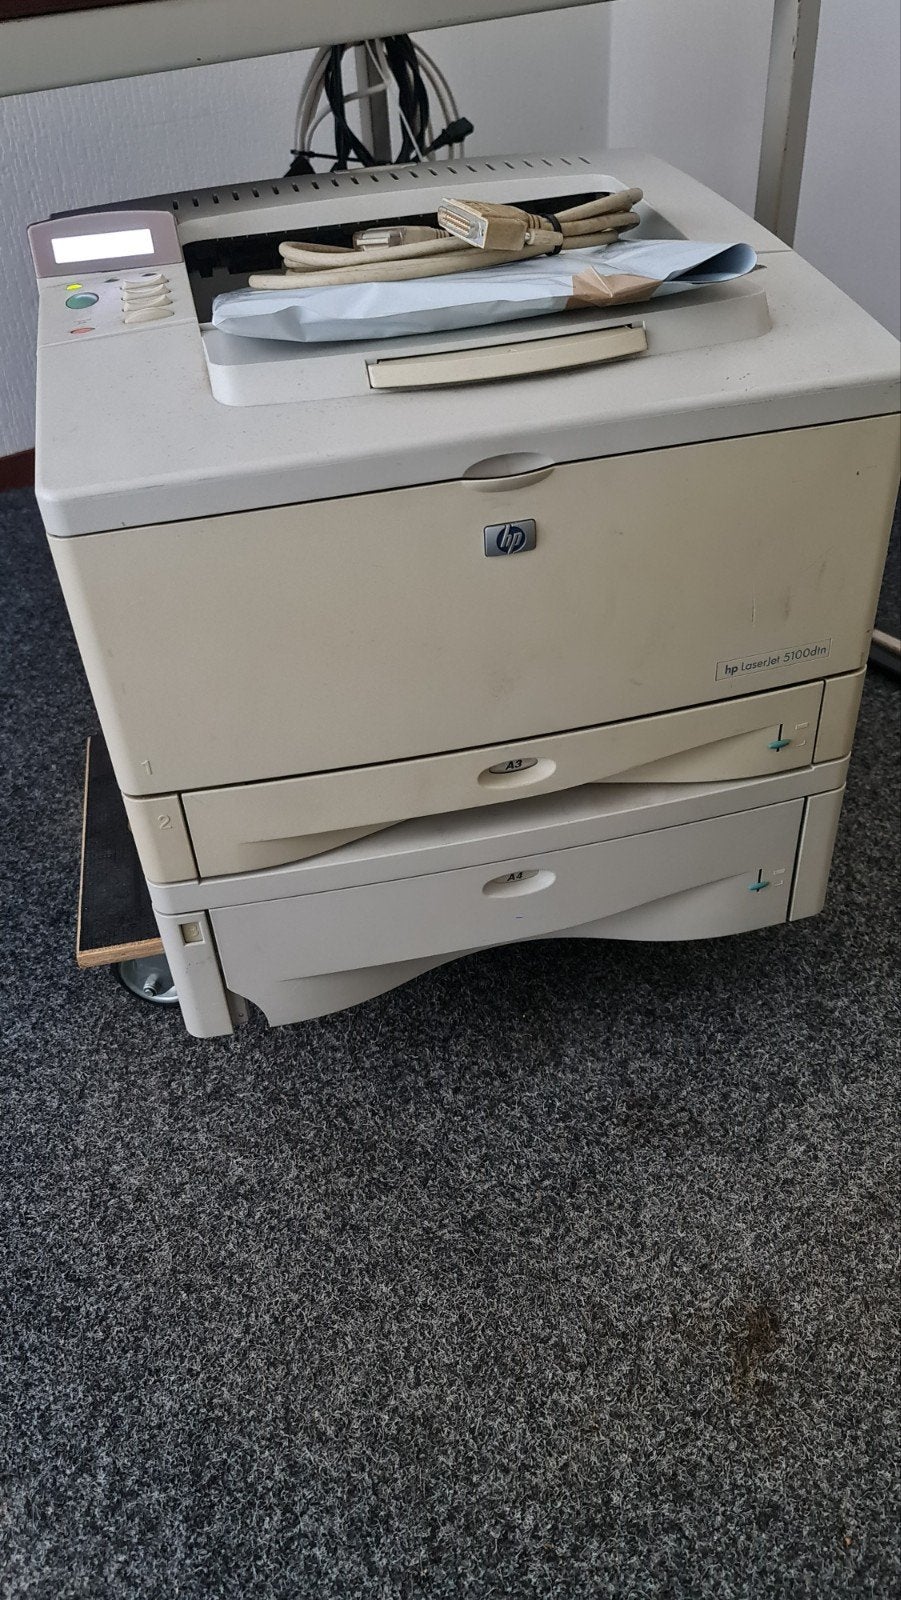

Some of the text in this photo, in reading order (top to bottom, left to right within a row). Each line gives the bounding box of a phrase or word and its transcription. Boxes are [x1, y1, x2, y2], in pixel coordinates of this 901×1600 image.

[499, 524, 523, 555] hp
[724, 645, 827, 676] hp LaserJet 5100dtn
[141, 760, 154, 776] 1
[505, 759, 523, 770] A3
[158, 814, 173, 830] 2
[507, 872, 523, 882] A4
